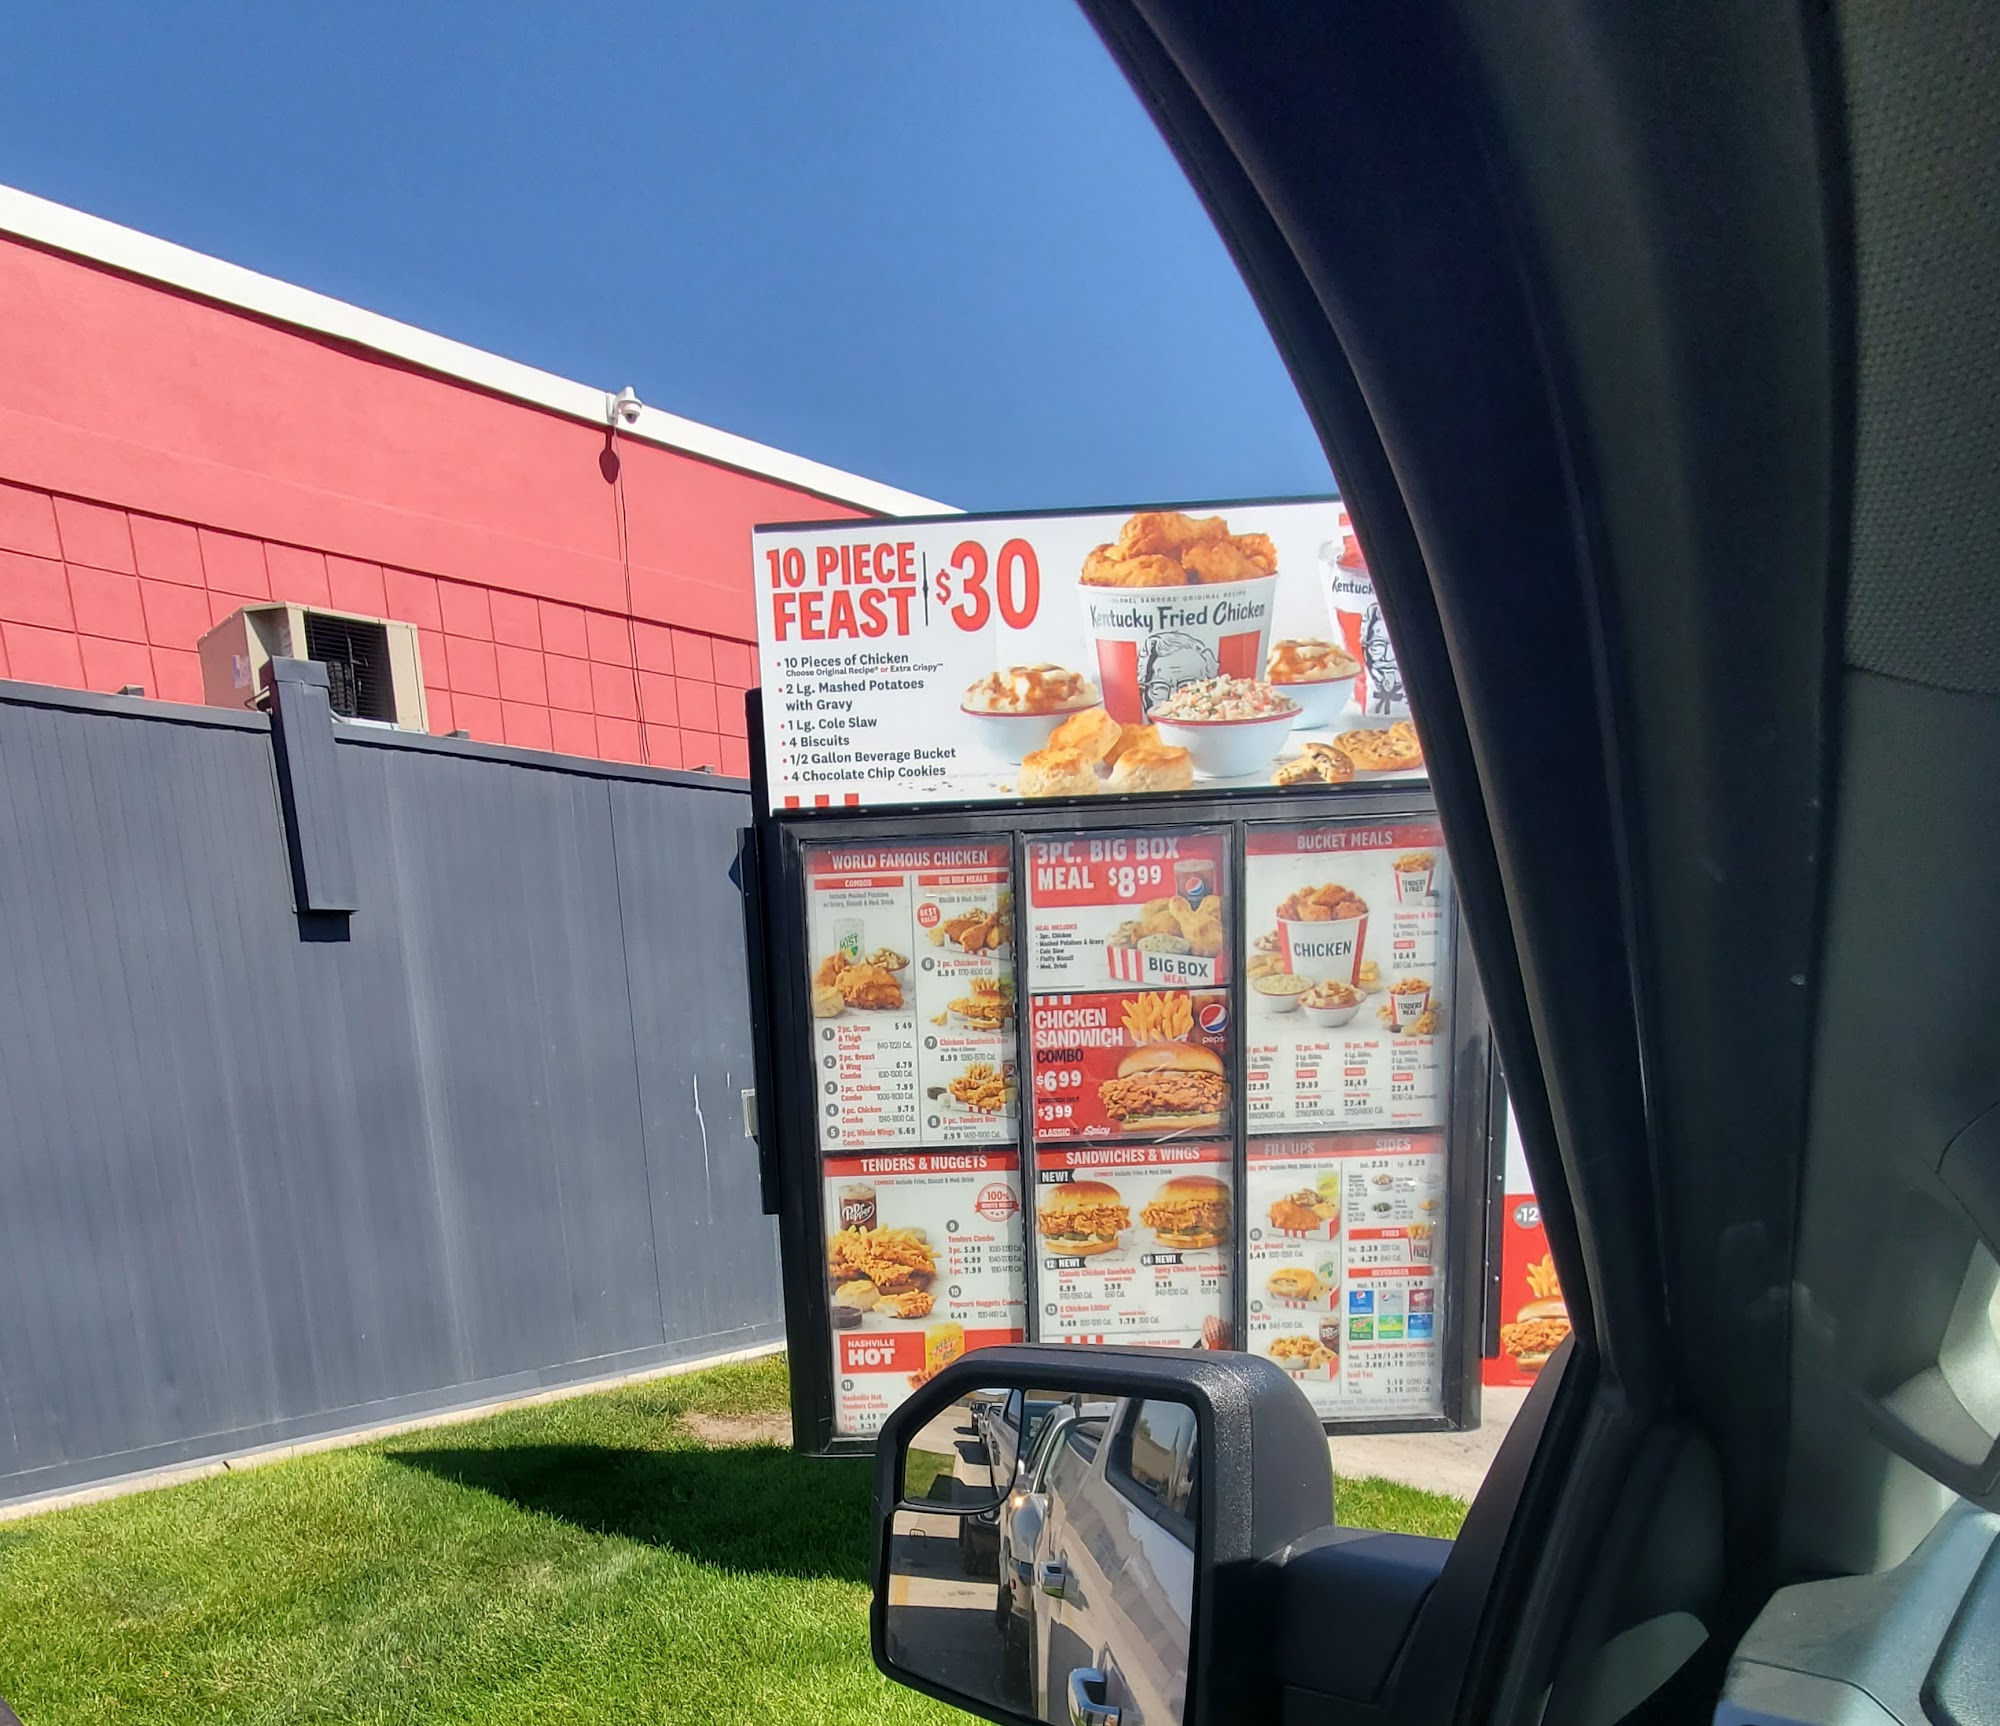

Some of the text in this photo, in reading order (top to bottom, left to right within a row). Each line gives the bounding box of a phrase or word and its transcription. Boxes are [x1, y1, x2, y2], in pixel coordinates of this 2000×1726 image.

[766, 542, 917, 589] 10 PIECE
[935, 538, 1040, 632] $30
[772, 587, 916, 642] FEAST
[1090, 600, 1265, 632] Kentucky Fried Chicken
[784, 652, 909, 668] 10 Pieces of Chicken
[816, 668, 847, 677] Original
[786, 680, 924, 696] 2 Lg. Mashed Potatoes
[786, 699, 852, 711] with Gravy
[788, 717, 877, 732] 1 Lg. Cole Slaw
[789, 735, 850, 747] 4 Biscuits
[790, 748, 956, 766] 1/2 Gallon Beverage Bucket
[791, 765, 946, 781] 4 Chocolate Chip Cookies
[1298, 831, 1393, 850] BUCKET MEALS
[1037, 837, 1180, 864] 3PC. BIG BOX
[832, 850, 988, 869] WORLD FAMOUS CHICKEN
[952, 876, 965, 884] BOX
[966, 875, 988, 883] MEALS
[1038, 866, 1094, 891] MEAL
[920, 907, 937, 916] BEST
[840, 937, 859, 950] MIST
[1294, 940, 1352, 957] CHICKEN
[953, 959, 978, 967] Chicken
[1149, 957, 1208, 978] BIG BOX
[1164, 975, 1188, 985] MEAL
[1035, 1008, 1106, 1029] CHICKEN
[845, 1034, 862, 1043] Thigh
[1036, 1027, 1123, 1049] SANDWICH
[1037, 1049, 1084, 1063] COMBO
[857, 1084, 881, 1092] Chicken
[857, 1106, 882, 1114] Chicken
[842, 1116, 863, 1124] Combo
[960, 1116, 983, 1124] Tenders
[1038, 1124, 1111, 1137] CLASSIC Spicy
[1265, 1143, 1315, 1156] FILL UPS
[1376, 1138, 1411, 1152] SIDES
[1066, 1147, 1200, 1165] SANDWICHES & WINGS
[861, 1155, 987, 1172] TENDERS & NUGGETS
[1042, 1171, 1068, 1183] NEW!
[987, 1190, 1009, 1201] 100%
[852, 1203, 865, 1213] Dr
[948, 1235, 972, 1244] Tenders
[1059, 1258, 1080, 1268] NEW!
[1155, 1255, 1177, 1264] NEW!
[1173, 1265, 1197, 1273] Chicken
[950, 1301, 974, 1309] Popcorn
[976, 1300, 1000, 1308] Nuggets
[1066, 1304, 1090, 1312] Chicken
[848, 1339, 895, 1348] NASHVILLE
[848, 1348, 895, 1366] HOT
